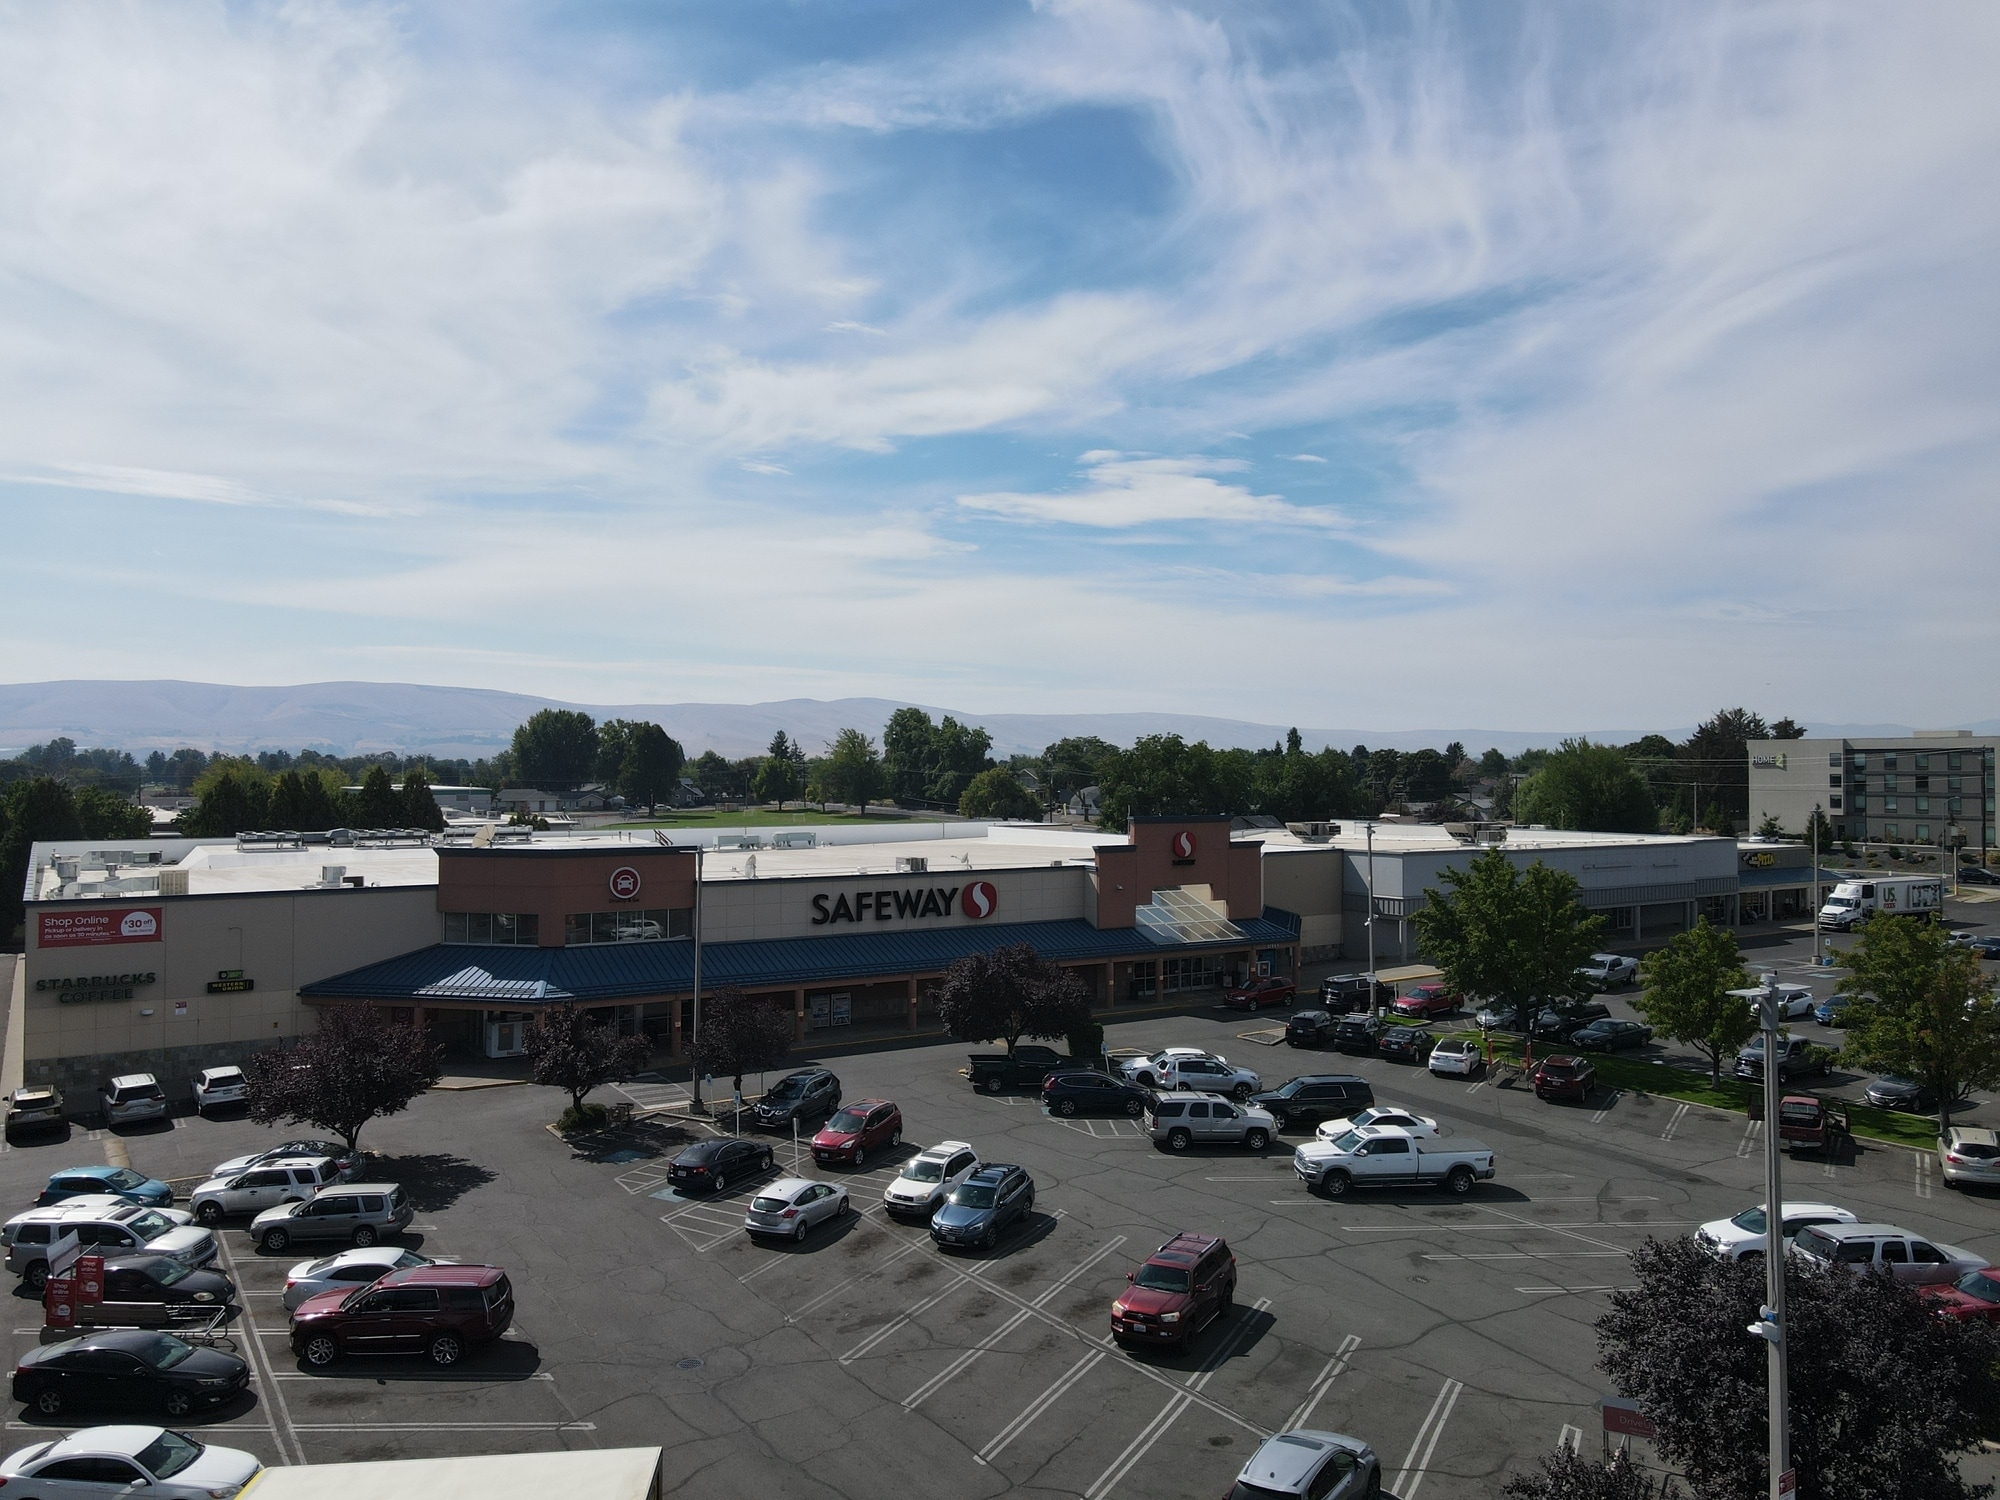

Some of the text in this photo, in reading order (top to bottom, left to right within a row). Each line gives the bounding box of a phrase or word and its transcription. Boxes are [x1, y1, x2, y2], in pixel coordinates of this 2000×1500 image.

[812, 887, 959, 925] SAFEWAY
[44, 916, 109, 928] Shop Online
[124, 919, 142, 928] $30
[72, 926, 96, 934] Delivery
[36, 972, 156, 991] STARBUCKS
[59, 988, 134, 1004] COFFEE
